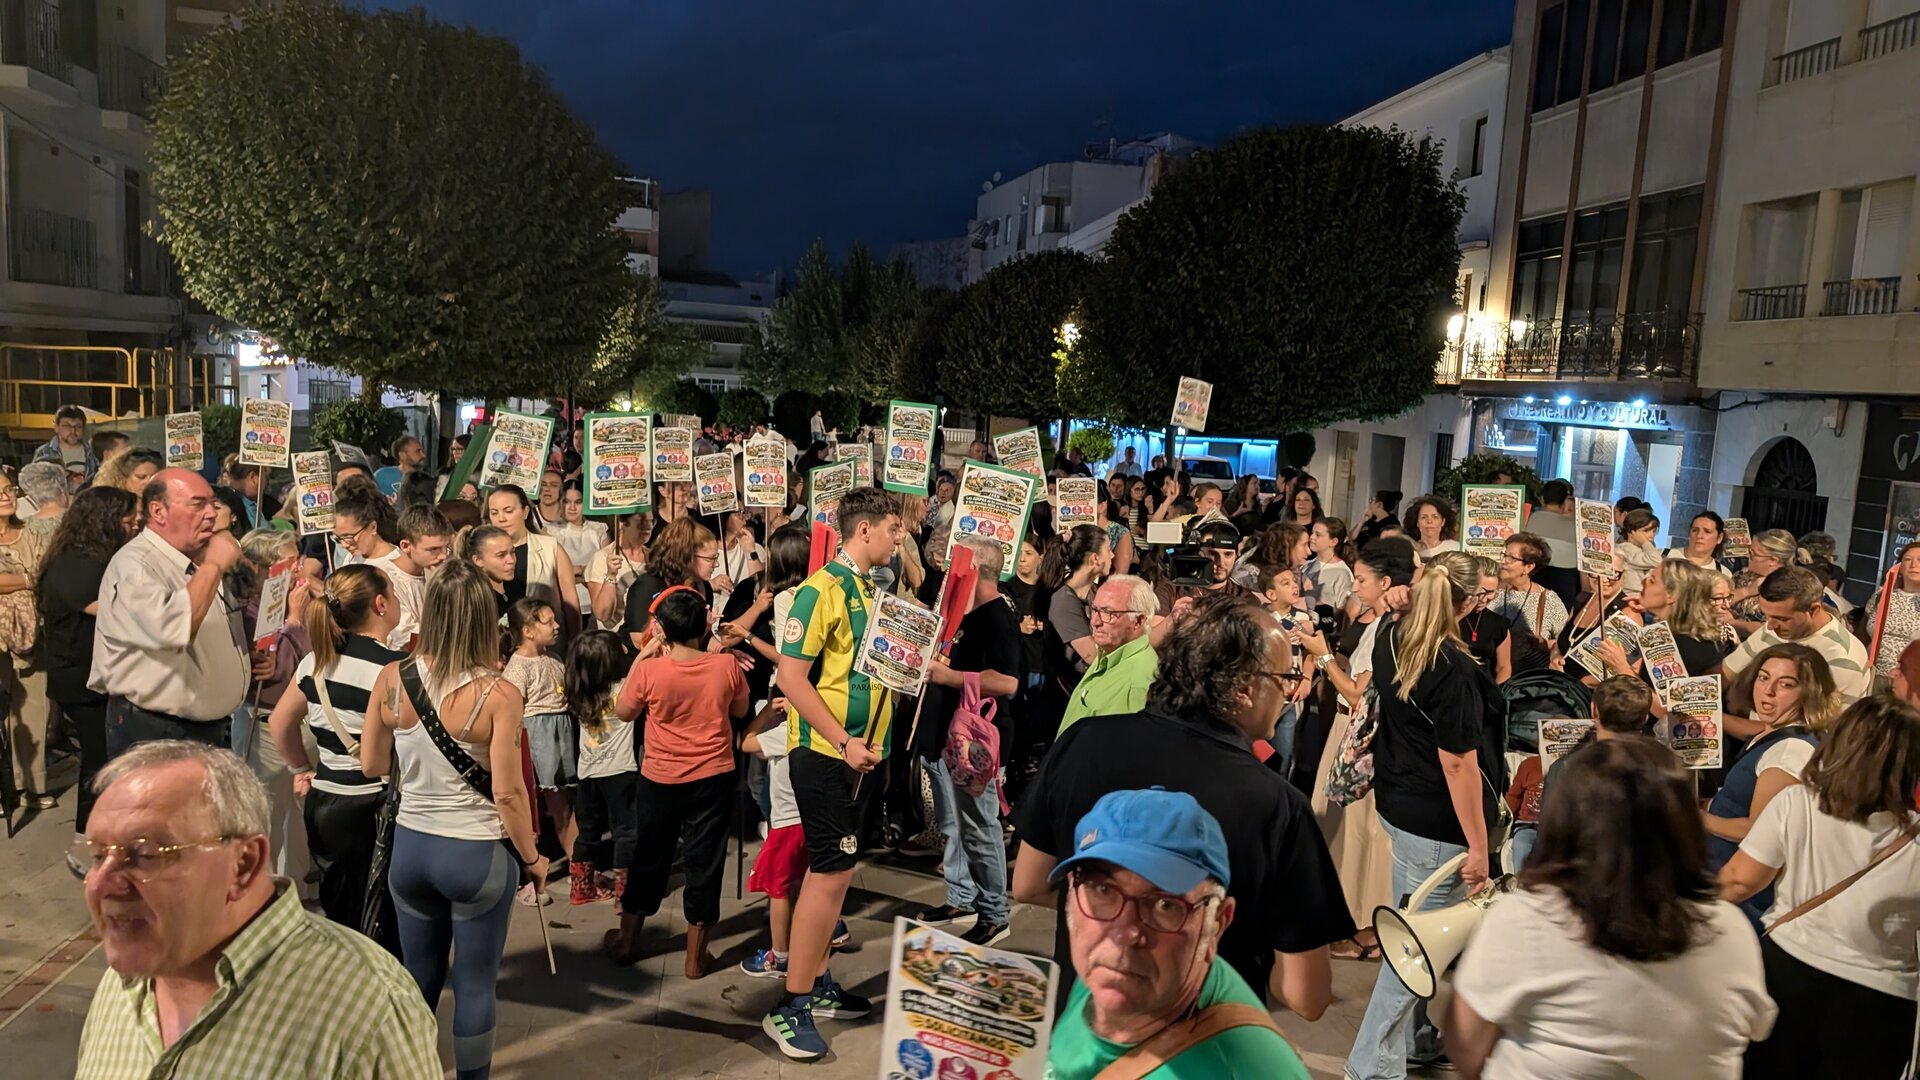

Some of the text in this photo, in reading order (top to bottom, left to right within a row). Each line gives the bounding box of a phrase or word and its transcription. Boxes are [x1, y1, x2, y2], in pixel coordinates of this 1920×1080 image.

[1600, 407, 1667, 425] CULTURAL
[975, 506, 1008, 517] SOLICITAMOS
[924, 1018, 1006, 1051] SOLICITAMOS
